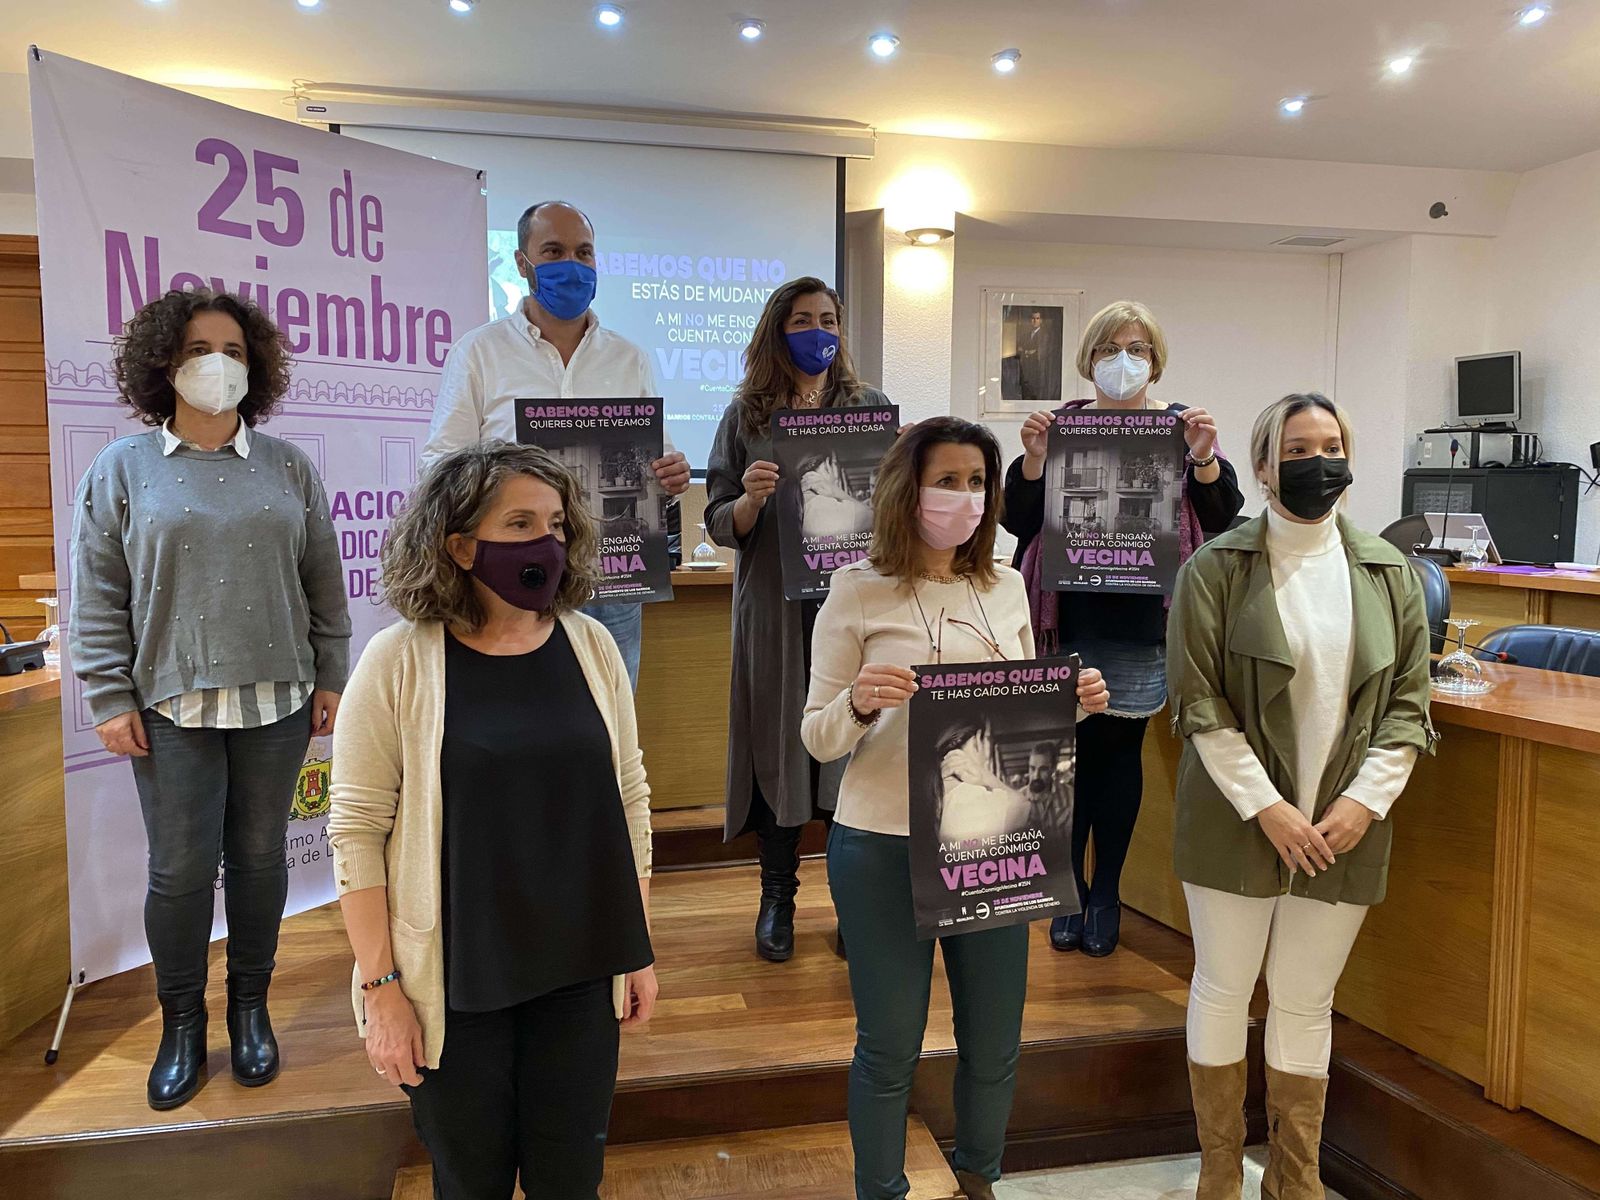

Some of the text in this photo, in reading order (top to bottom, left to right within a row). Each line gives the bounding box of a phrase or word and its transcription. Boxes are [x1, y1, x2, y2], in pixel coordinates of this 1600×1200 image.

[195, 137, 384, 263] 25 de
[596, 252, 786, 283] ABEMOS QUE NO
[105, 230, 452, 369] Niembre
[632, 280, 773, 304] ESTÁS DE MUDANZ
[655, 312, 756, 328] A MI NO ME ENG
[668, 328, 752, 344] CUENTA CON
[656, 348, 746, 381] VECI
[525, 405, 655, 418] SABEMOS QUE NO
[779, 411, 892, 427] SABEMOS QUE NO
[529, 417, 651, 429] QUIERES QUE TE VEAMOS
[1056, 415, 1177, 427] SABEMOS QUE NO
[787, 424, 885, 436] TE HAS CAÍDO EN CASA
[1059, 427, 1097, 435] QUIERES
[1099, 427, 1118, 436] QUE
[1132, 428, 1172, 436] VEAMOS
[603, 534, 645, 545] ENGAÑA,
[850, 532, 874, 540] ENGA
[1107, 540, 1151, 548] CONMIGO
[1116, 532, 1155, 541] ENGAÑA,
[806, 540, 874, 552] CUENTA CONMI
[803, 550, 871, 570] VECI
[1066, 548, 1155, 566] VECINA
[921, 665, 1071, 689] SABEMOS QUE NO
[930, 683, 1060, 700] TE HAS CAÍDO EN CASA
[938, 829, 1046, 853] A MI NO ME ENGAÑA,
[301, 849, 320, 865] de
[944, 840, 1040, 863] CUENTA CONMIGO
[939, 854, 1047, 891] VECINA
